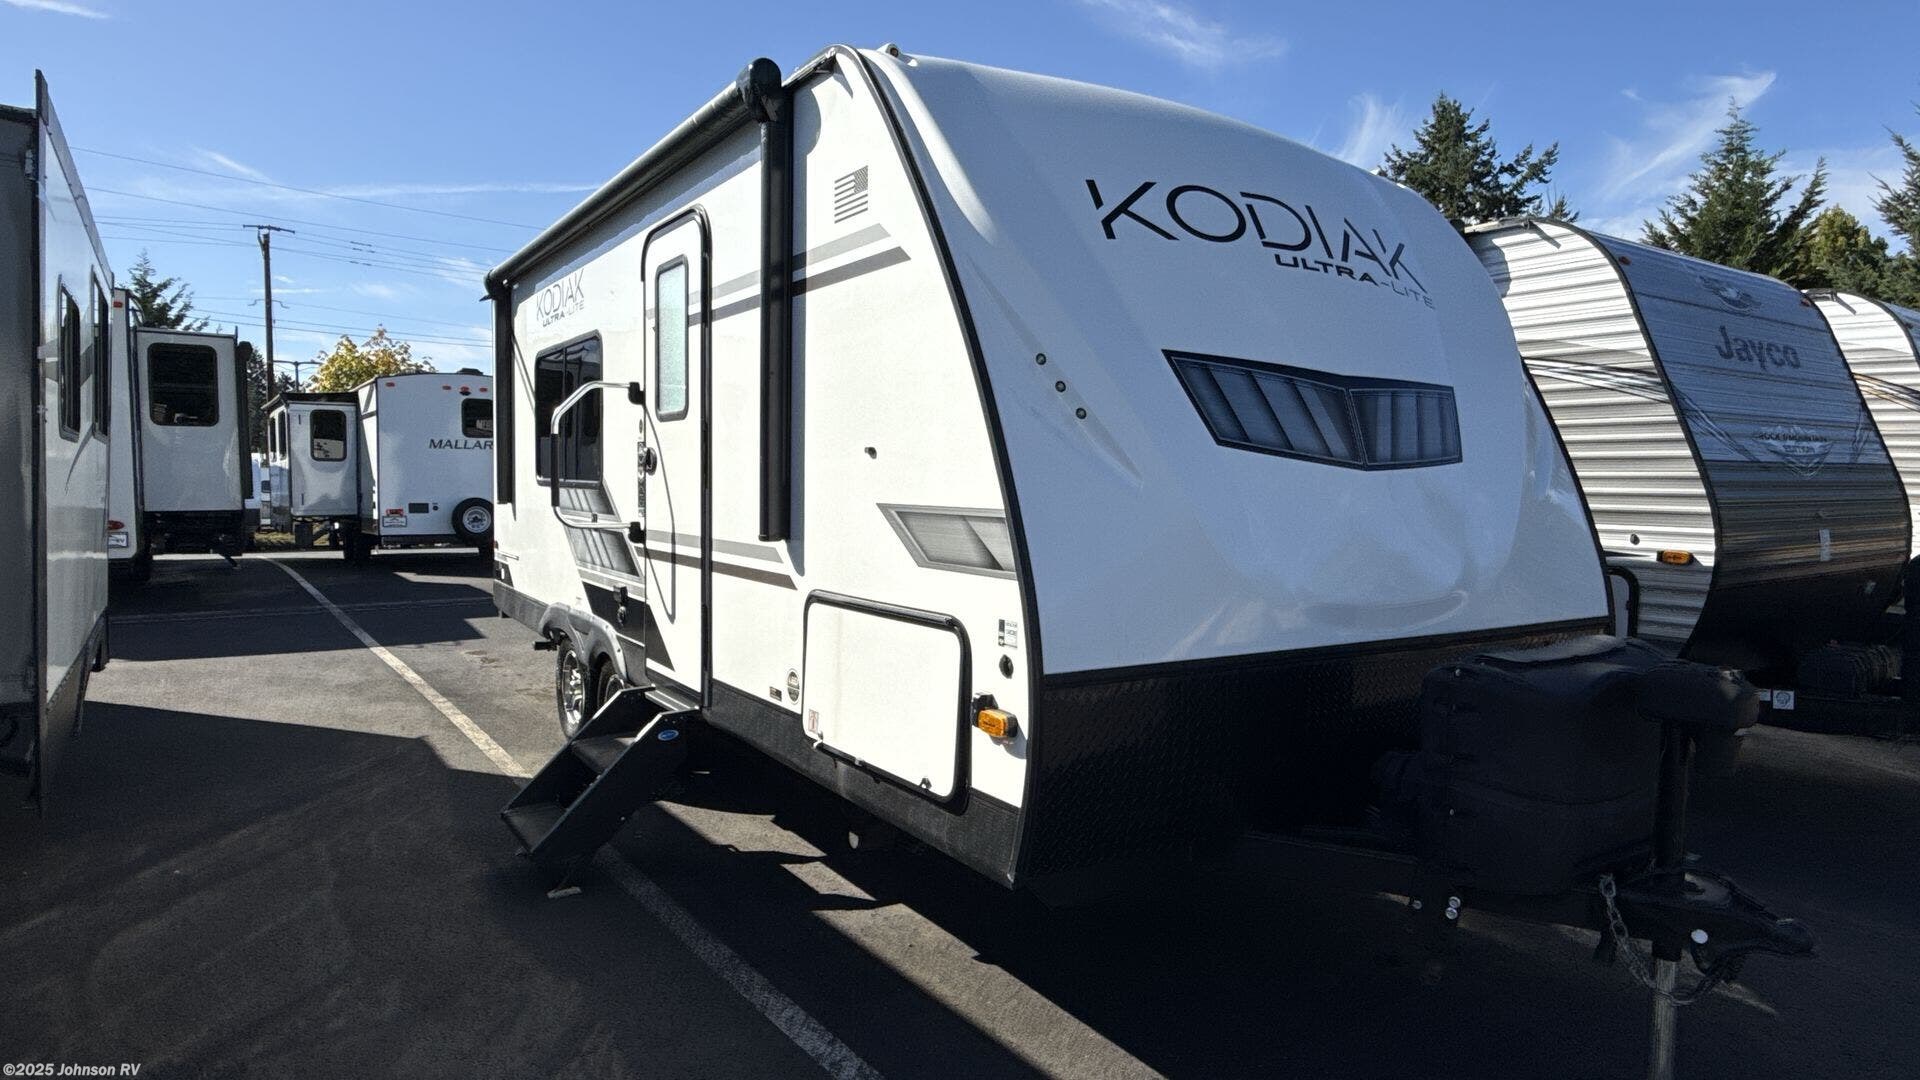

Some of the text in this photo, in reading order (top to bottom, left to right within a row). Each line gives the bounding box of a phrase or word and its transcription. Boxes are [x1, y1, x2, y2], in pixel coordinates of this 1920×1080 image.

[1085, 179, 1427, 293] KODIAK
[536, 268, 584, 321] KODIAK
[1275, 254, 1436, 310] ULTRA-LITE
[1715, 325, 1800, 370] Jayco
[429, 438, 493, 450] MALLAR
